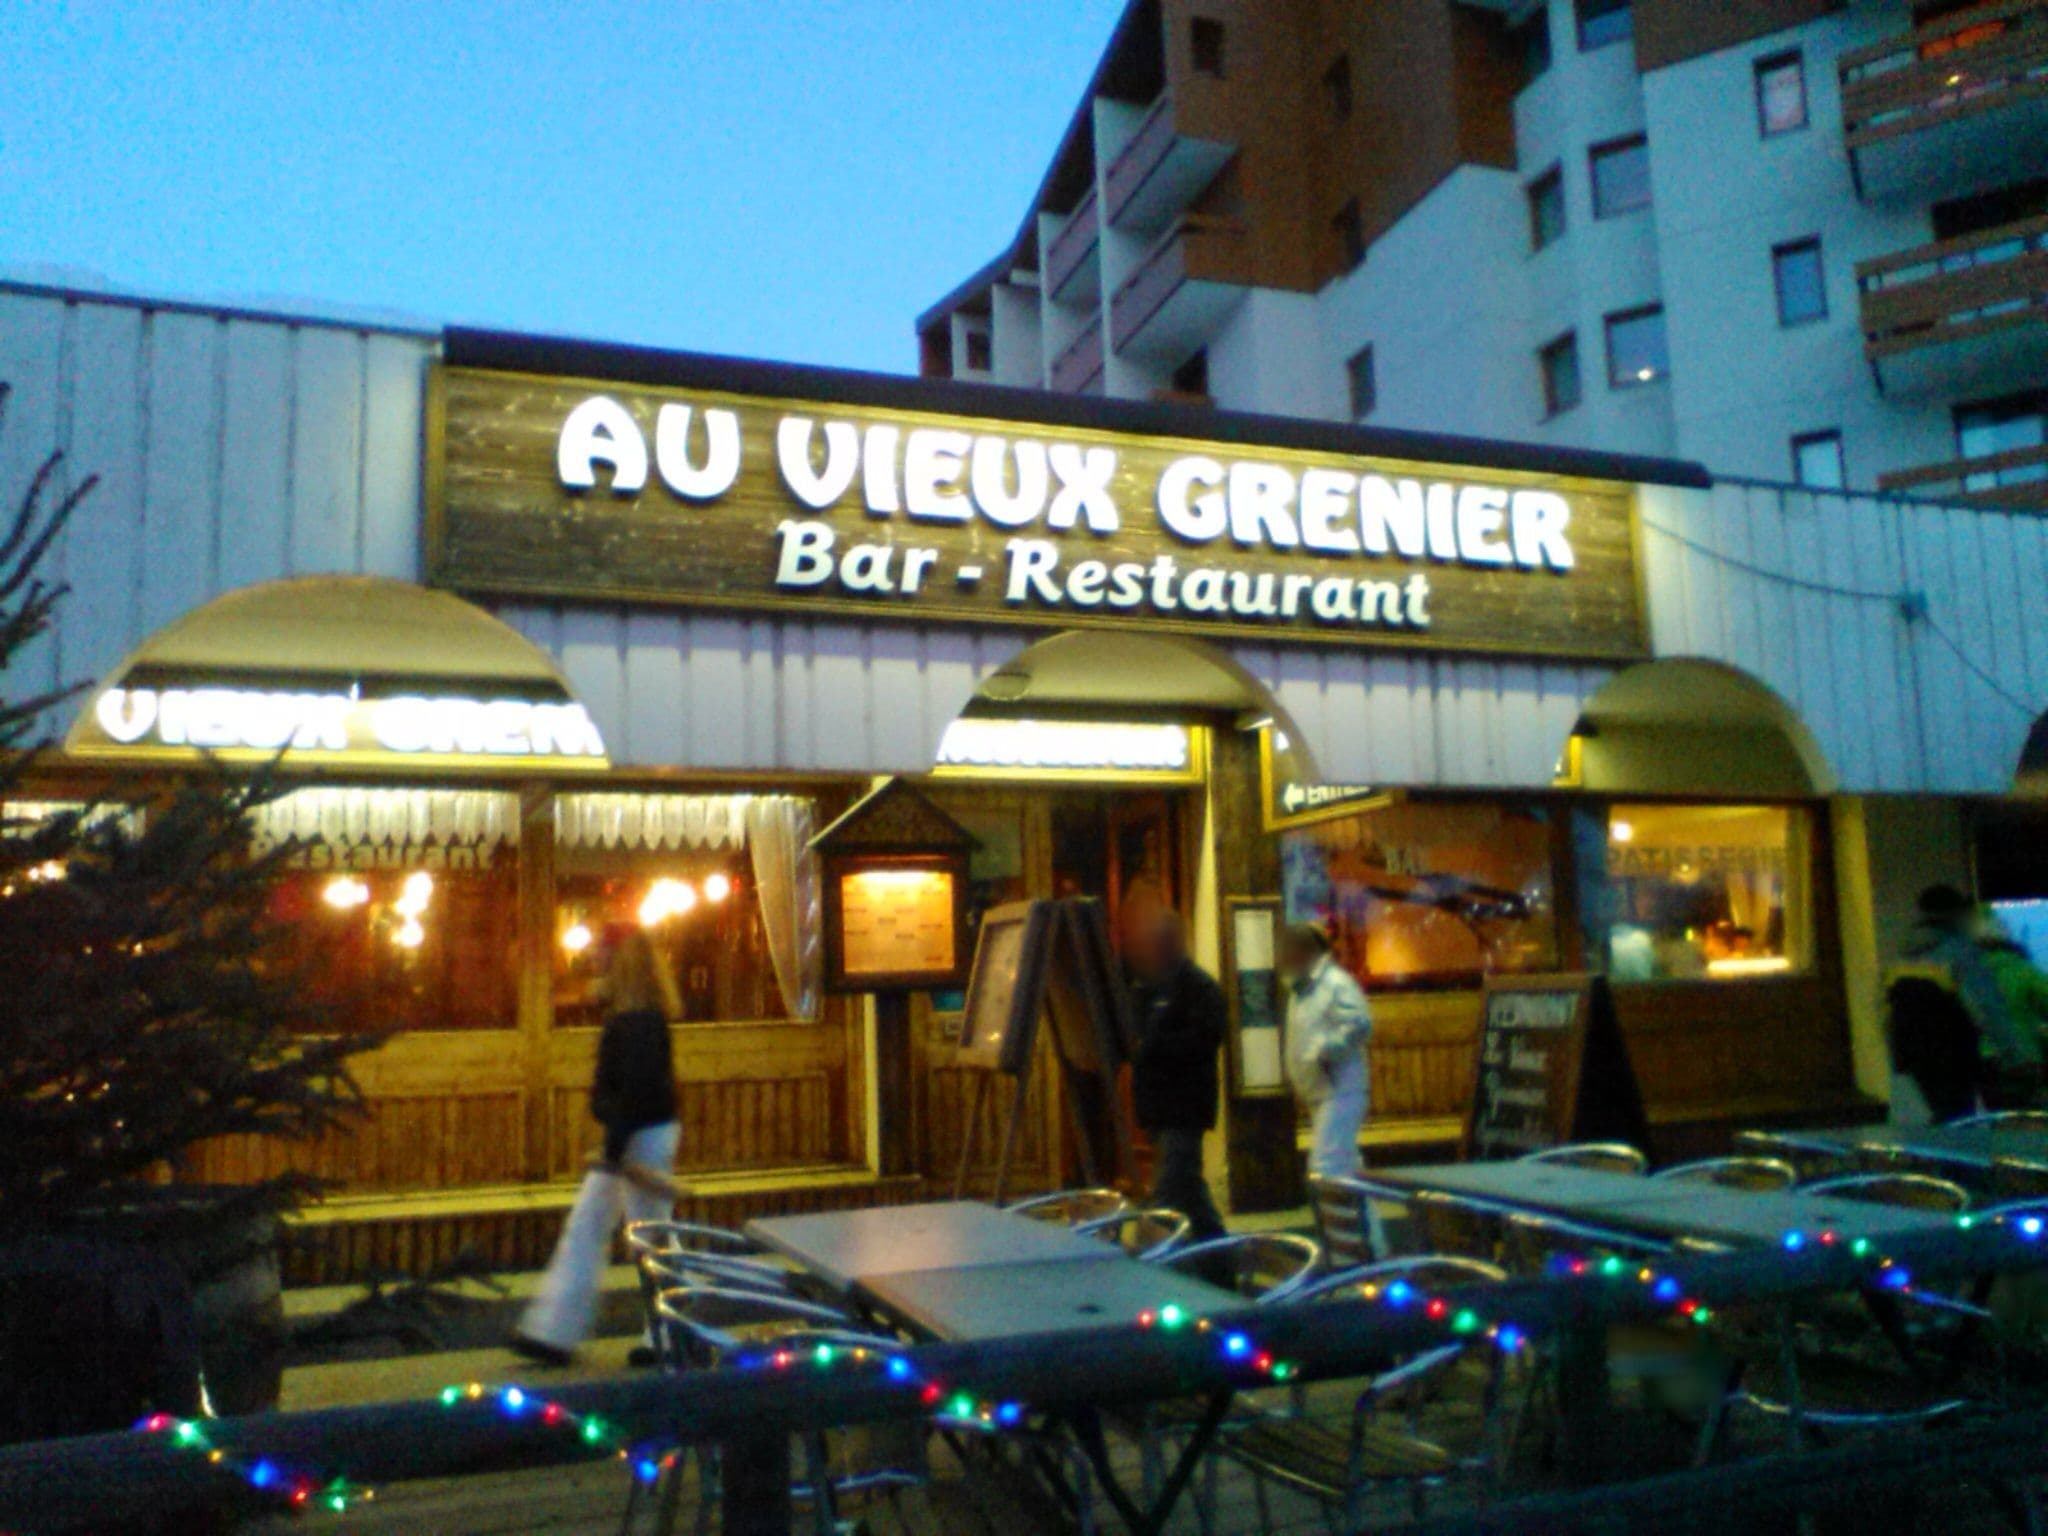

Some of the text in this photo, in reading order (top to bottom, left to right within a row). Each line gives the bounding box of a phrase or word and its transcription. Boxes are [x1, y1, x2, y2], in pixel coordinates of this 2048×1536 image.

[557, 396, 1574, 569] AU VIEUX GRENIER
[775, 519, 1431, 627] Bar - Restaurant
